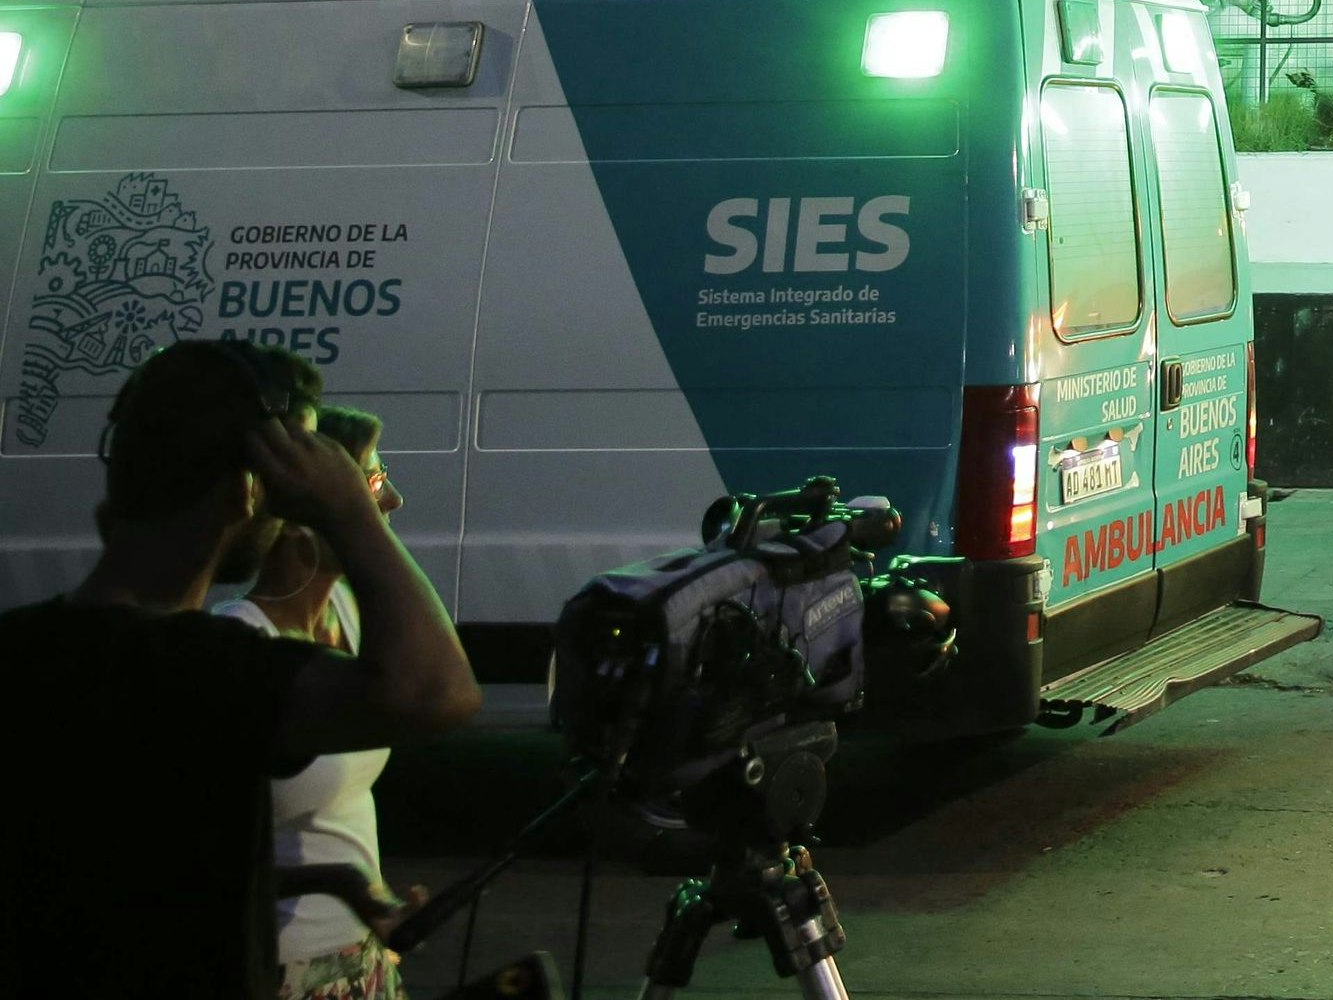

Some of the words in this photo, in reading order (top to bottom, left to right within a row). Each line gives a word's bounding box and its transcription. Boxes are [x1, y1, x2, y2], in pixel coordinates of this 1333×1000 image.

[230, 225, 341, 244] GOBIERNO
[347, 224, 376, 243] DE
[382, 223, 409, 241] LA
[704, 195, 911, 275] SIES
[225, 251, 341, 270] PROVINCIA
[346, 250, 376, 268] DE
[218, 278, 403, 319] BUENOS
[698, 288, 765, 305] Sistema
[770, 285, 854, 306] Integrado
[858, 284, 880, 301] de
[696, 309, 806, 330] Emergencias
[810, 307, 897, 326] Sanitarias
[1217, 354, 1227, 370] DE
[1227, 351, 1236, 367] LA
[1057, 370, 1121, 402] MINISTERIO
[1122, 367, 1137, 388] DE
[1217, 375, 1227, 391] DE
[1102, 396, 1137, 423] SALUD
[1180, 395, 1237, 439] BUENOS
[1178, 437, 1220, 480] AIRES
[1233, 441, 1239, 463] 4
[1066, 471, 1080, 498] AD
[1083, 465, 1103, 492] 481
[1063, 485, 1226, 588] AMBULANCIA
